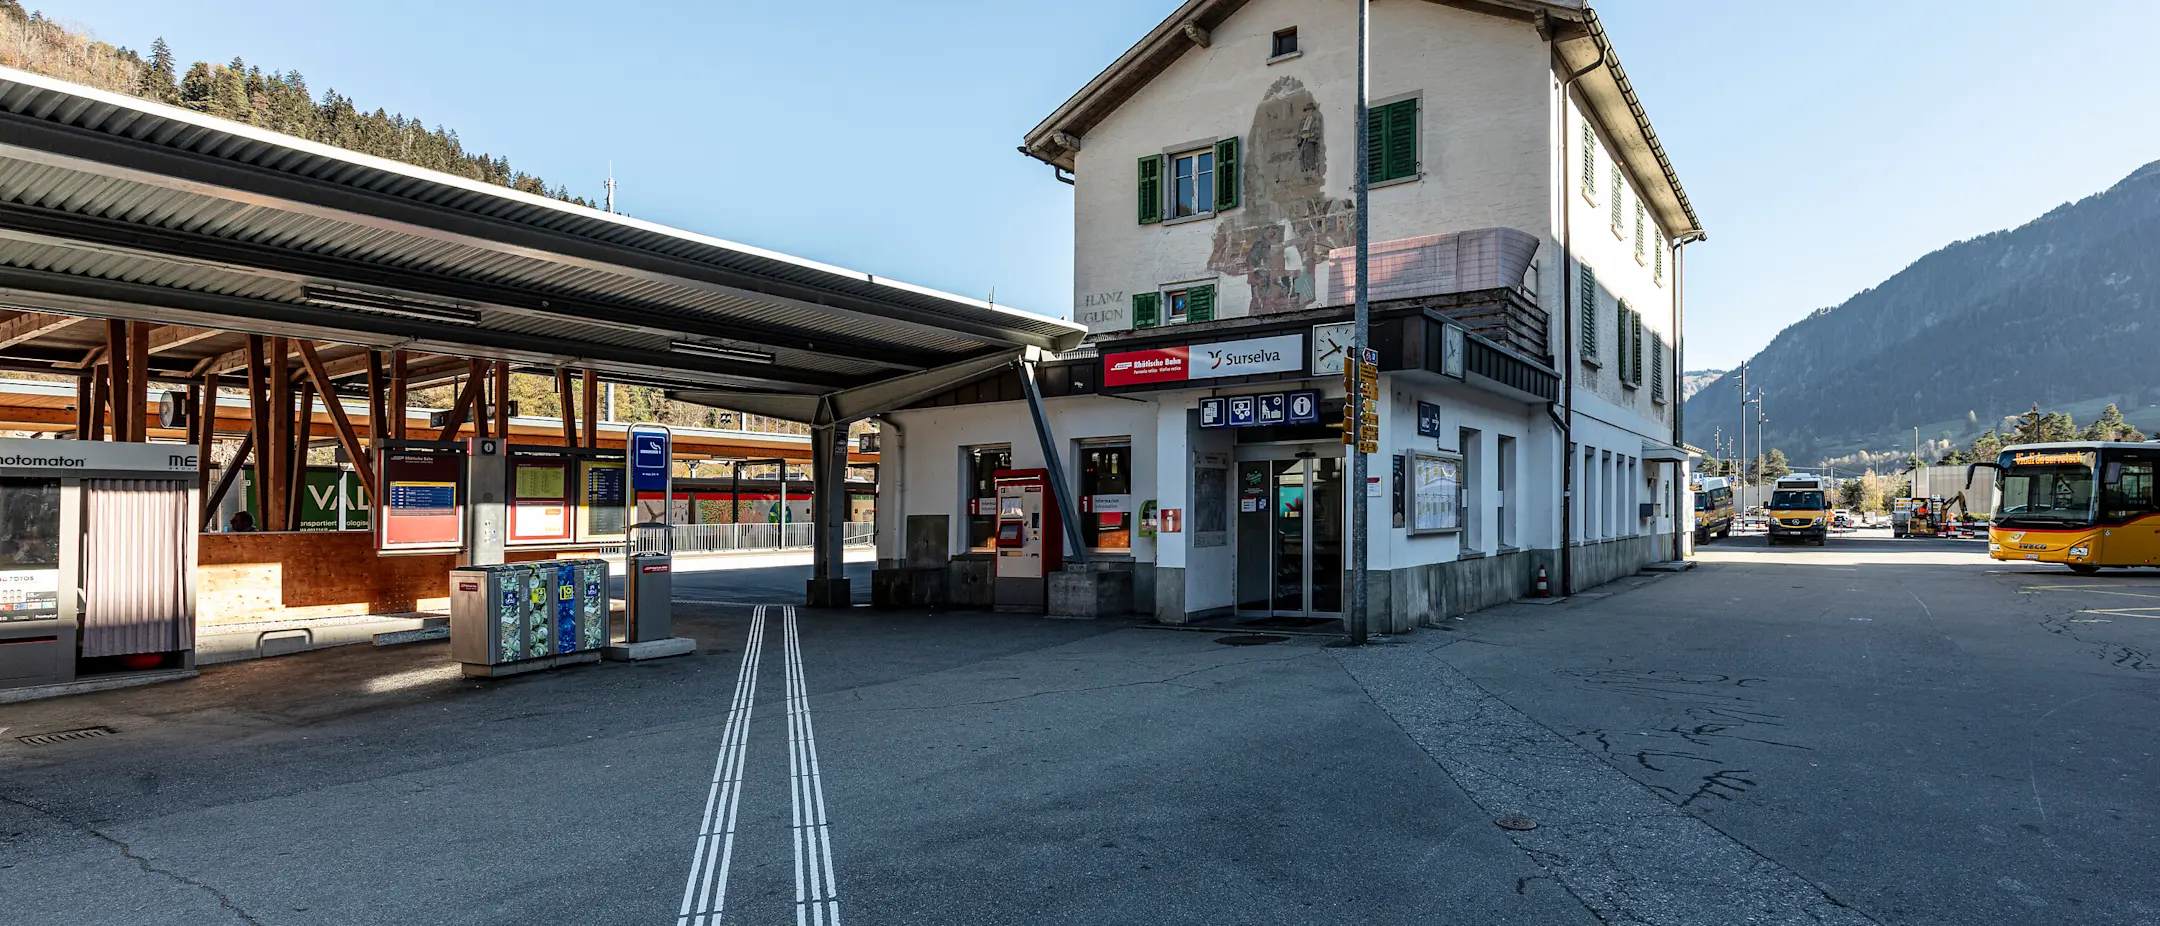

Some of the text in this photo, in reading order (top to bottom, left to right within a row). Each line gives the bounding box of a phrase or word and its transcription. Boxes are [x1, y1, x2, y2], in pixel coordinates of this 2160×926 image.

[1086, 291, 1123, 307] ILANZ
[1084, 309, 1123, 324] GLION
[1134, 357, 1181, 368] Rhätische Bahn
[1226, 349, 1280, 366] Surselva
[169, 455, 197, 467] ME
